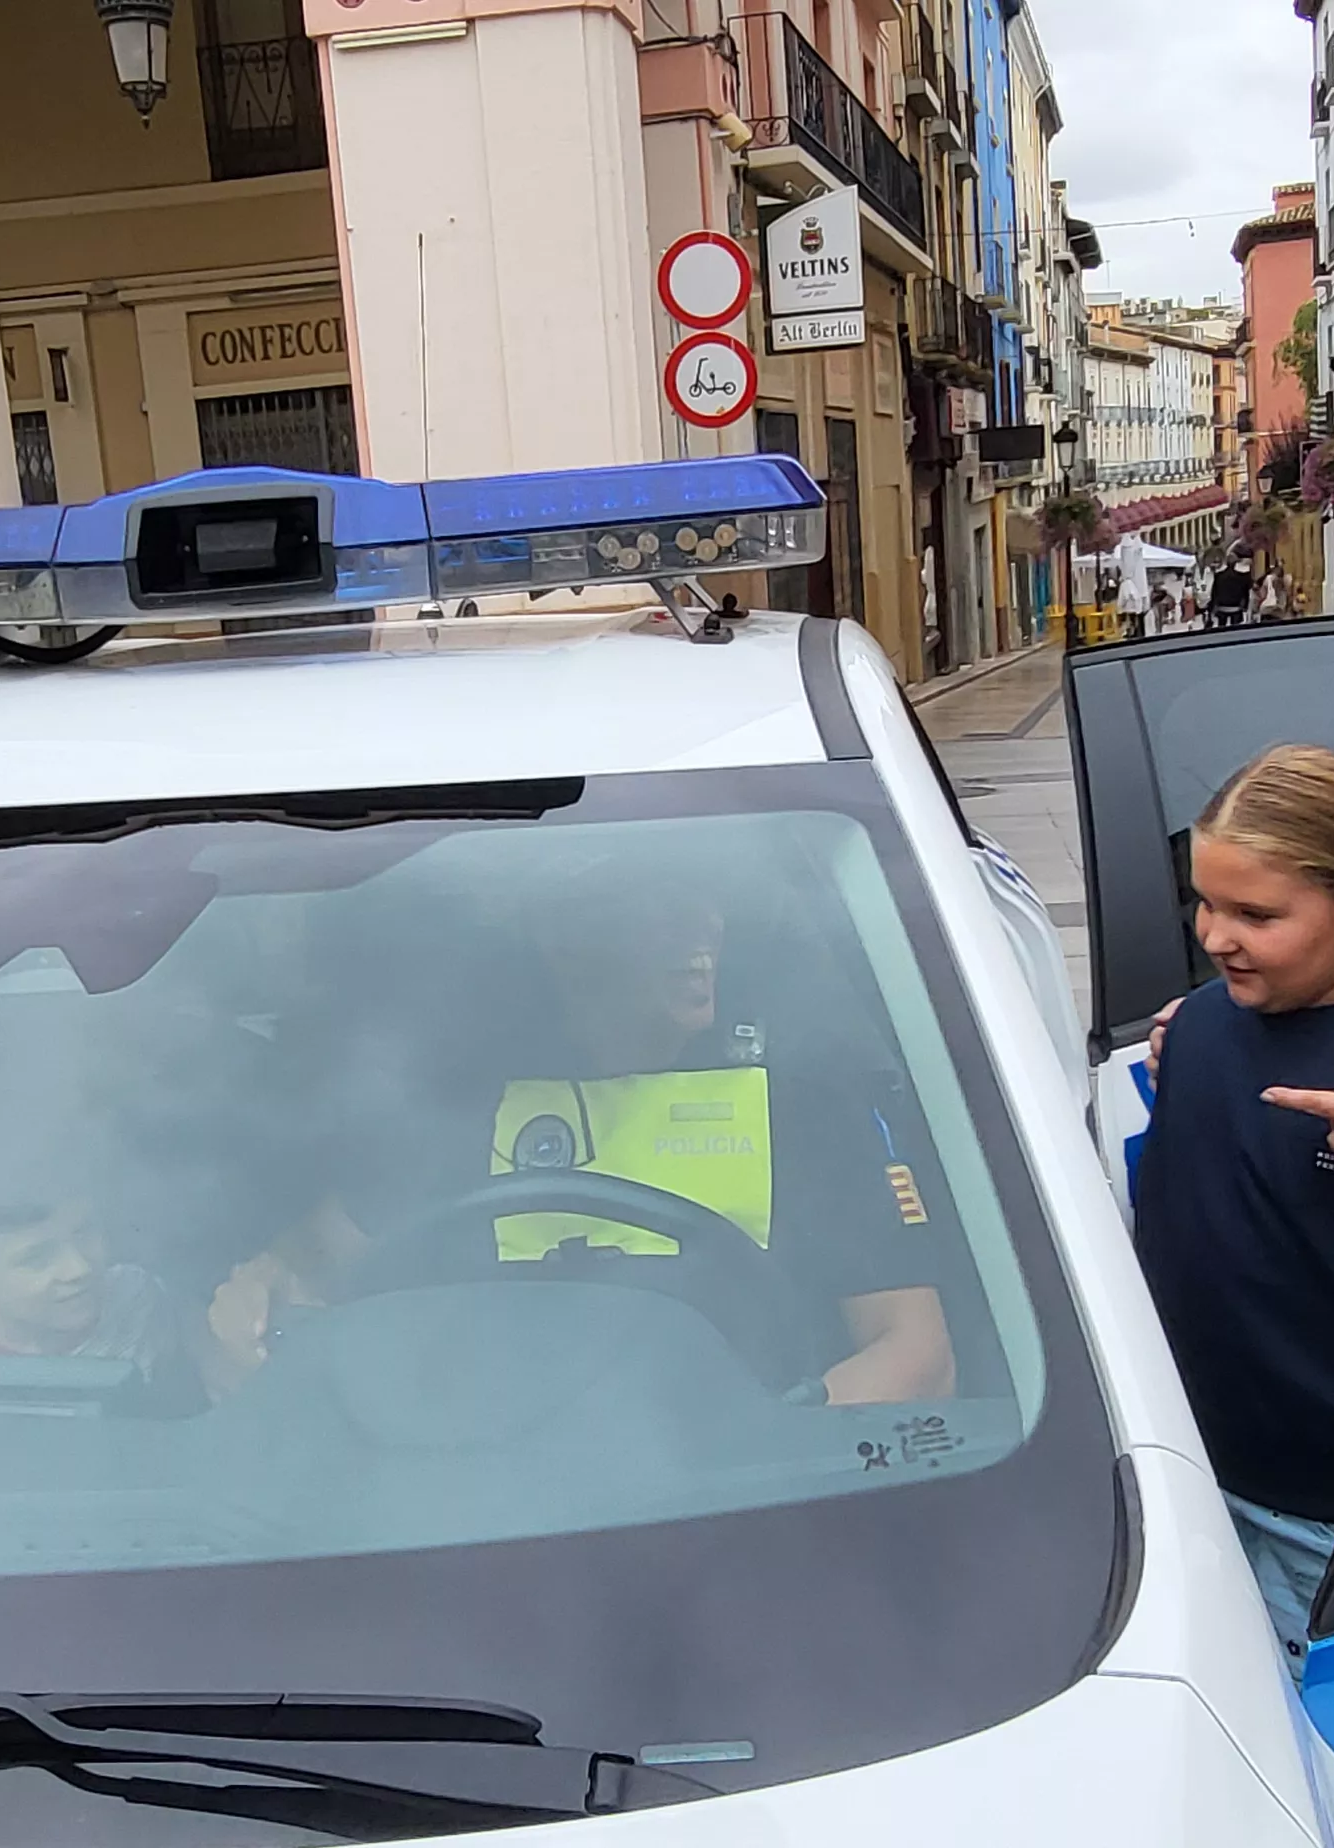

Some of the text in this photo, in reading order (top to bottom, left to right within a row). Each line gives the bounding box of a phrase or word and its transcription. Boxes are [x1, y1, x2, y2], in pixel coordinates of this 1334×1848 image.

[778, 256, 850, 280] VELTINS
[779, 320, 858, 342] Alt Berlin
